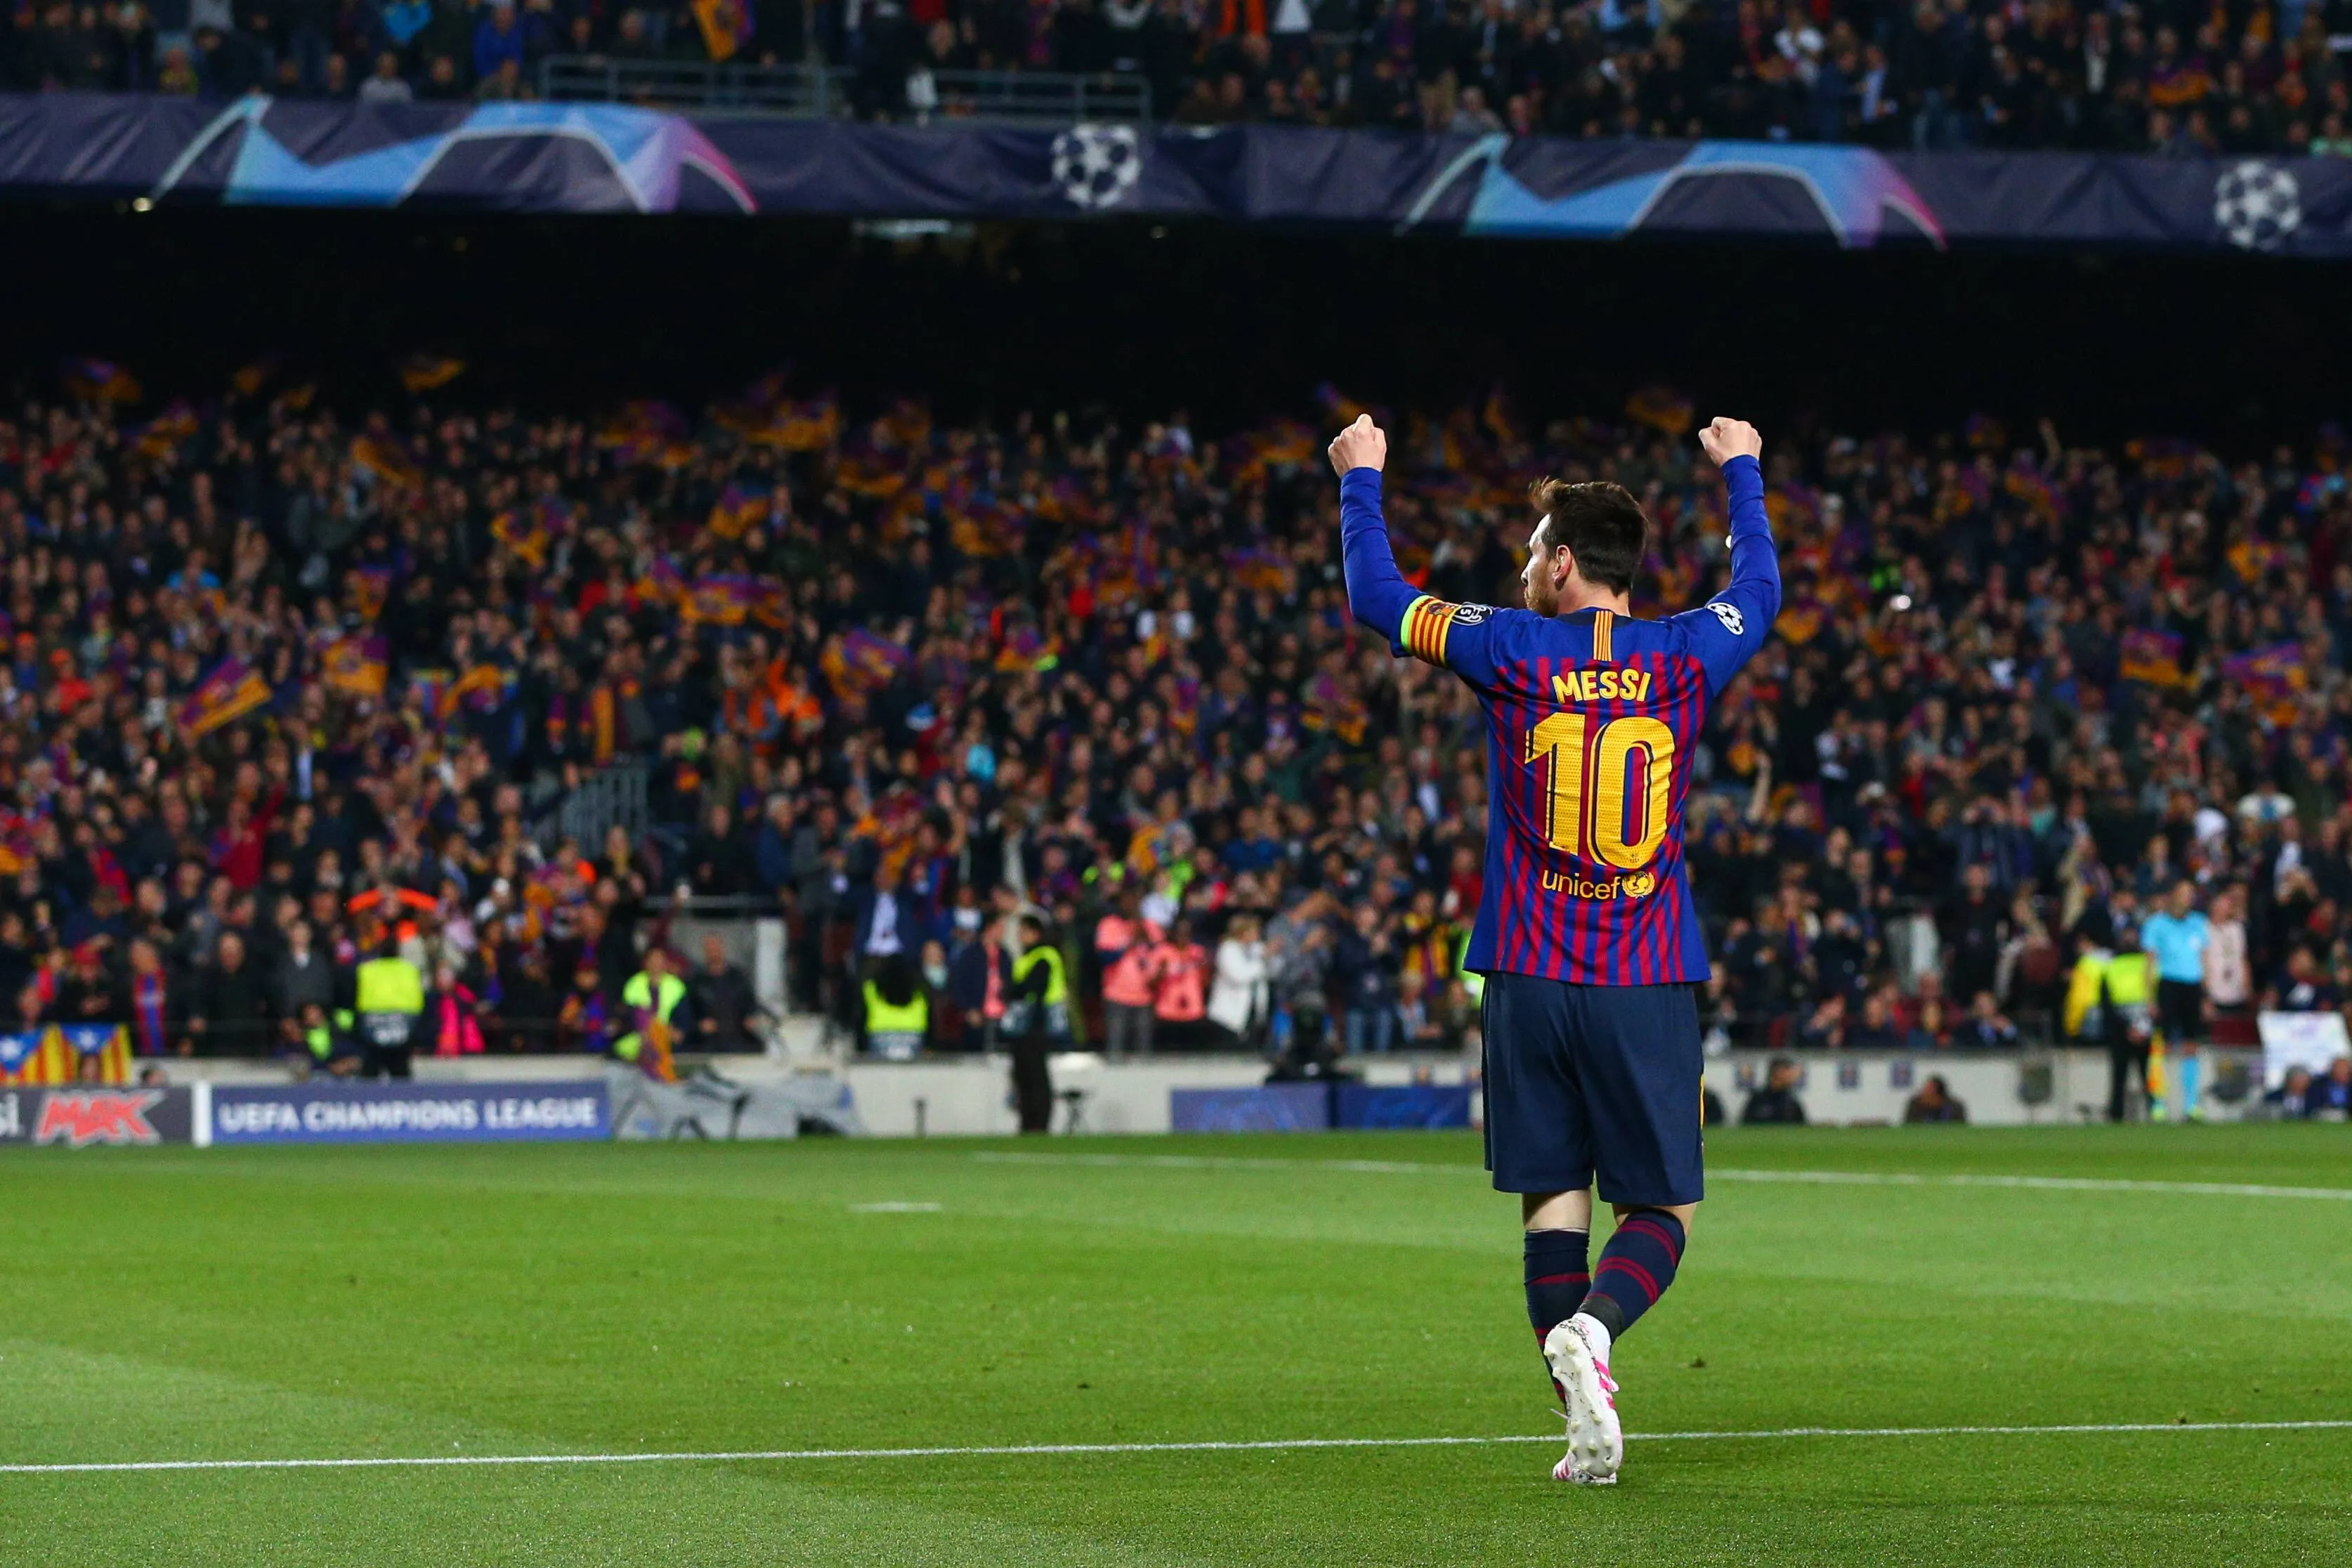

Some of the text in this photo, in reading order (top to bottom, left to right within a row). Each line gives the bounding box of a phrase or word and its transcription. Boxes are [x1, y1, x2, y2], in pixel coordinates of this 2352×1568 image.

[1551, 668, 1652, 704] MESSI
[1524, 712, 1675, 870] 10
[1542, 870, 1621, 900] unicef
[218, 1095, 599, 1134] UEFA CHAMPIONS LEAGUE
